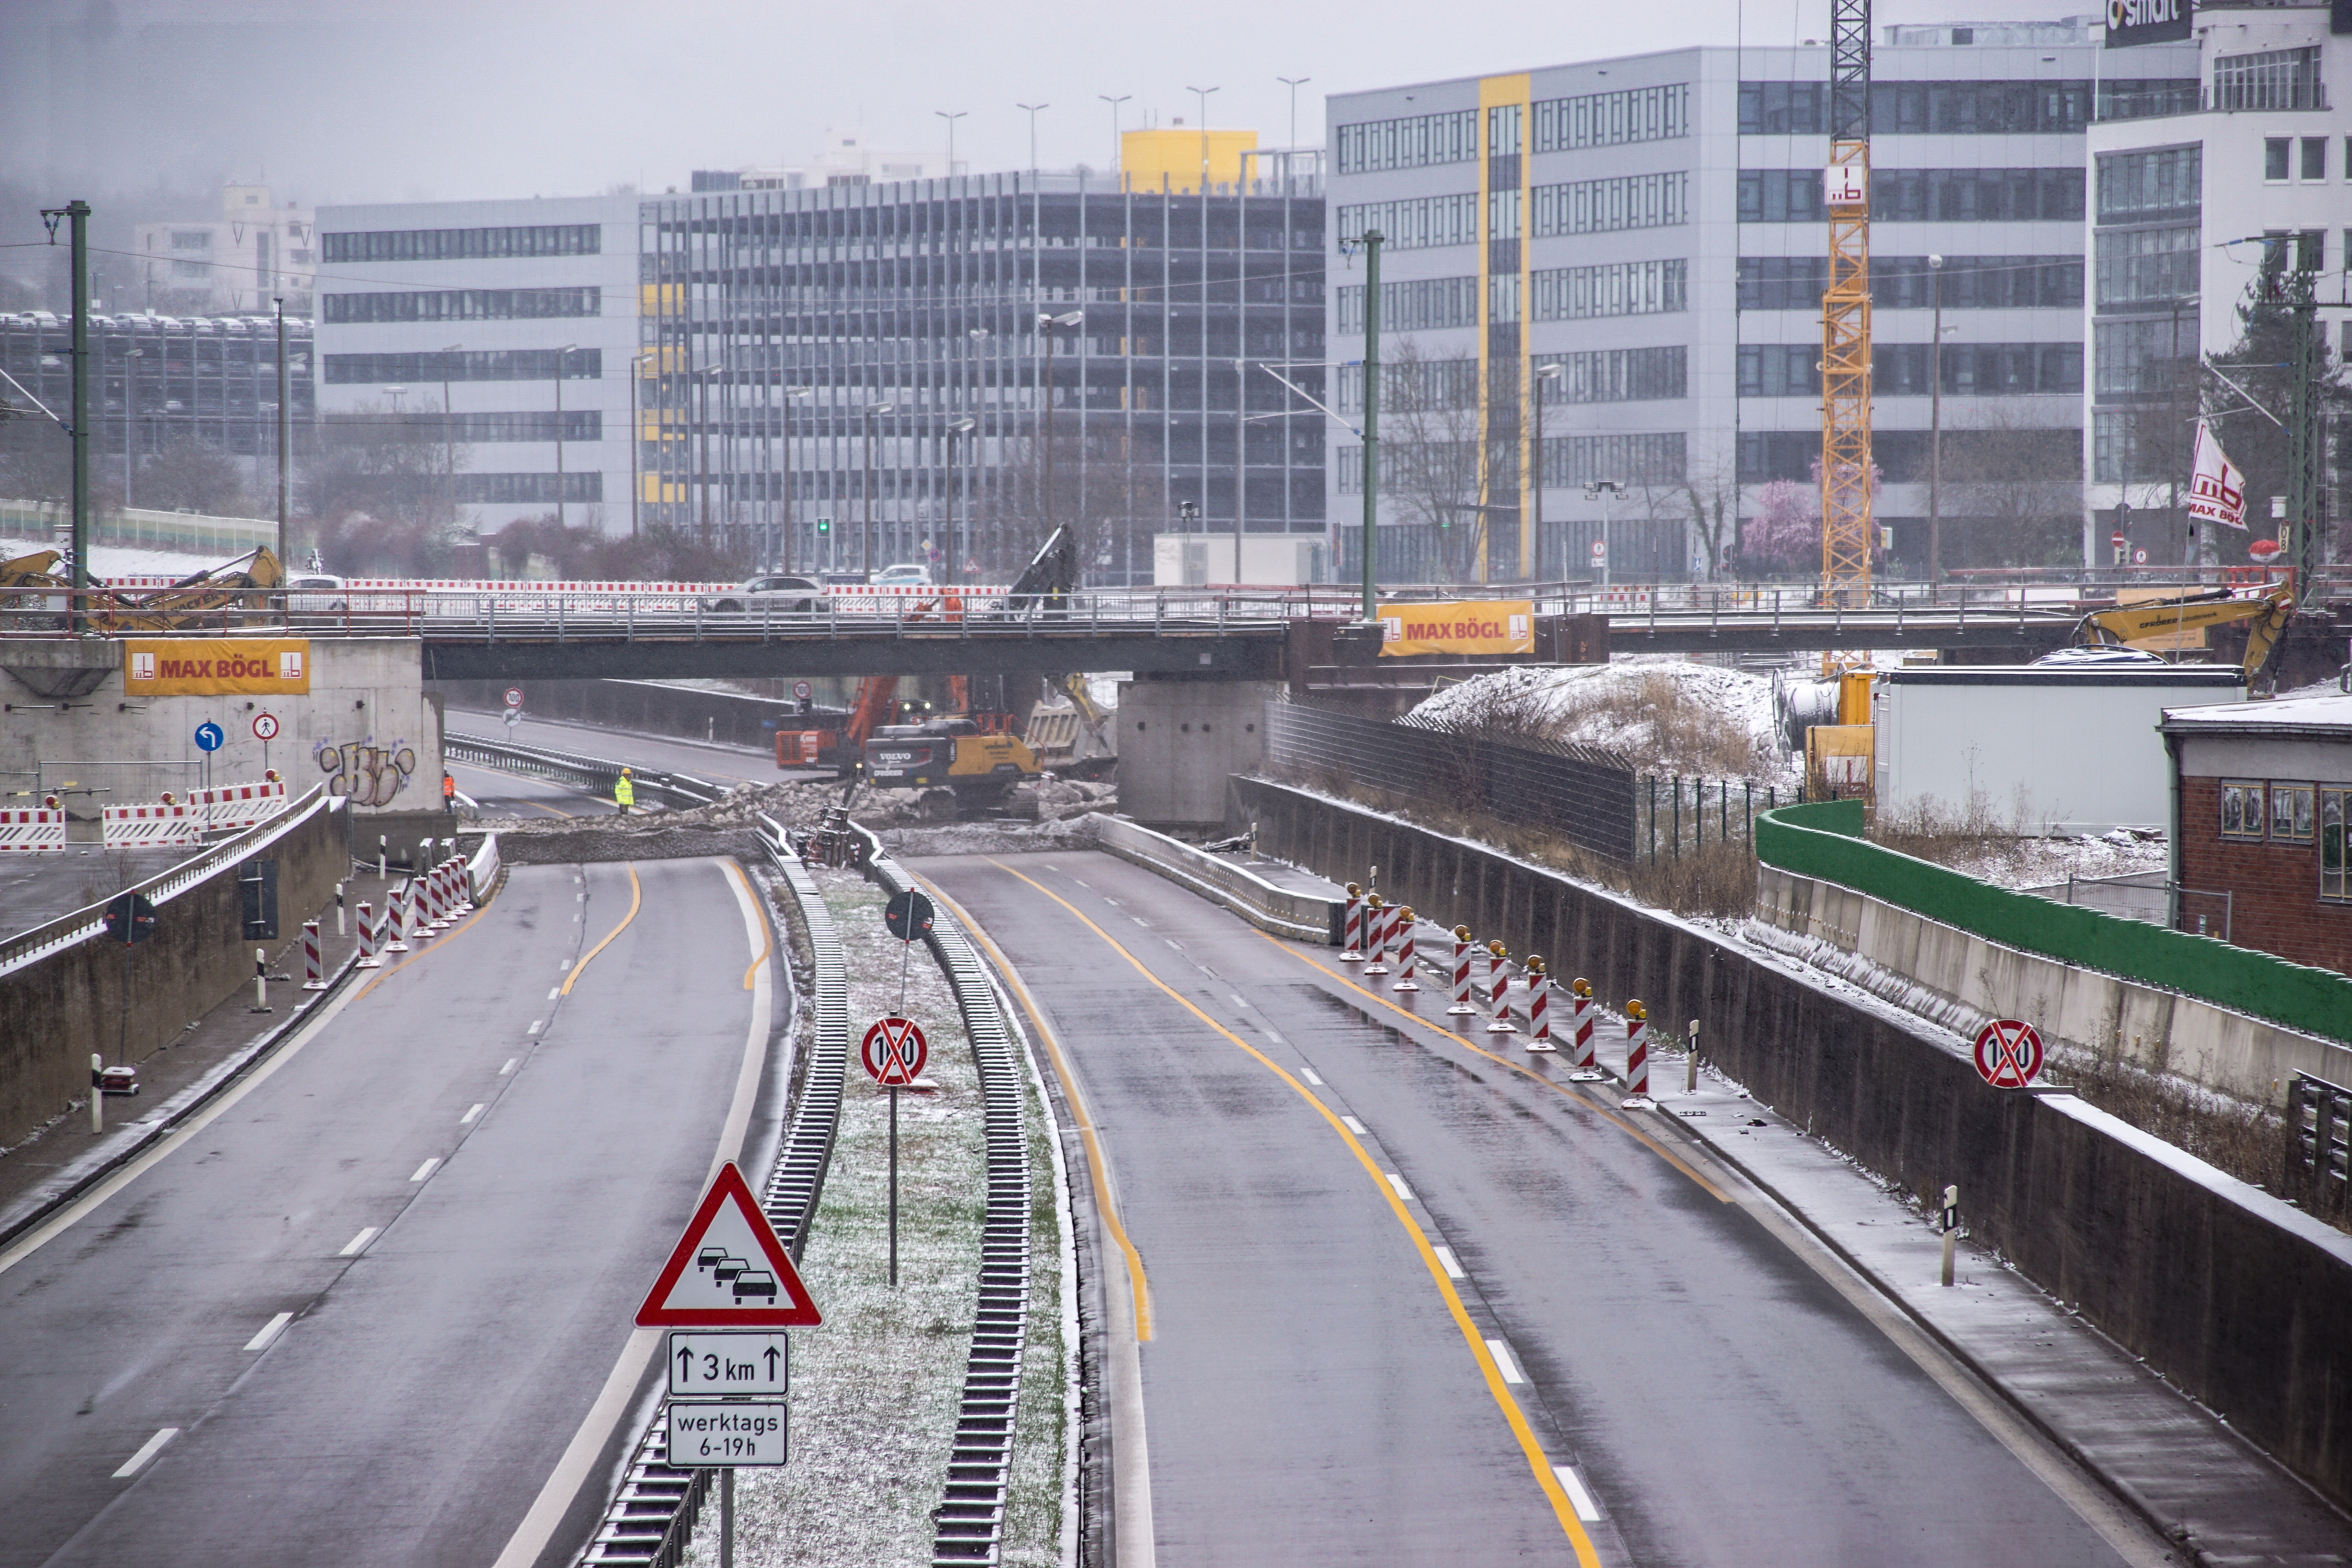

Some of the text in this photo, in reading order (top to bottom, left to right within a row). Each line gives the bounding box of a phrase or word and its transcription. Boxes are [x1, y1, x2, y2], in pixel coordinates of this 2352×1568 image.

[2189, 503, 2216, 517] MAX
[1407, 623, 1452, 640] MAX
[1455, 617, 1504, 639] BÖGL
[160, 660, 212, 678] MAX
[216, 654, 274, 678] BÖGL
[508, 693, 519, 702] 100
[702, 1354, 755, 1381] 3 km
[677, 1413, 778, 1436] werktags
